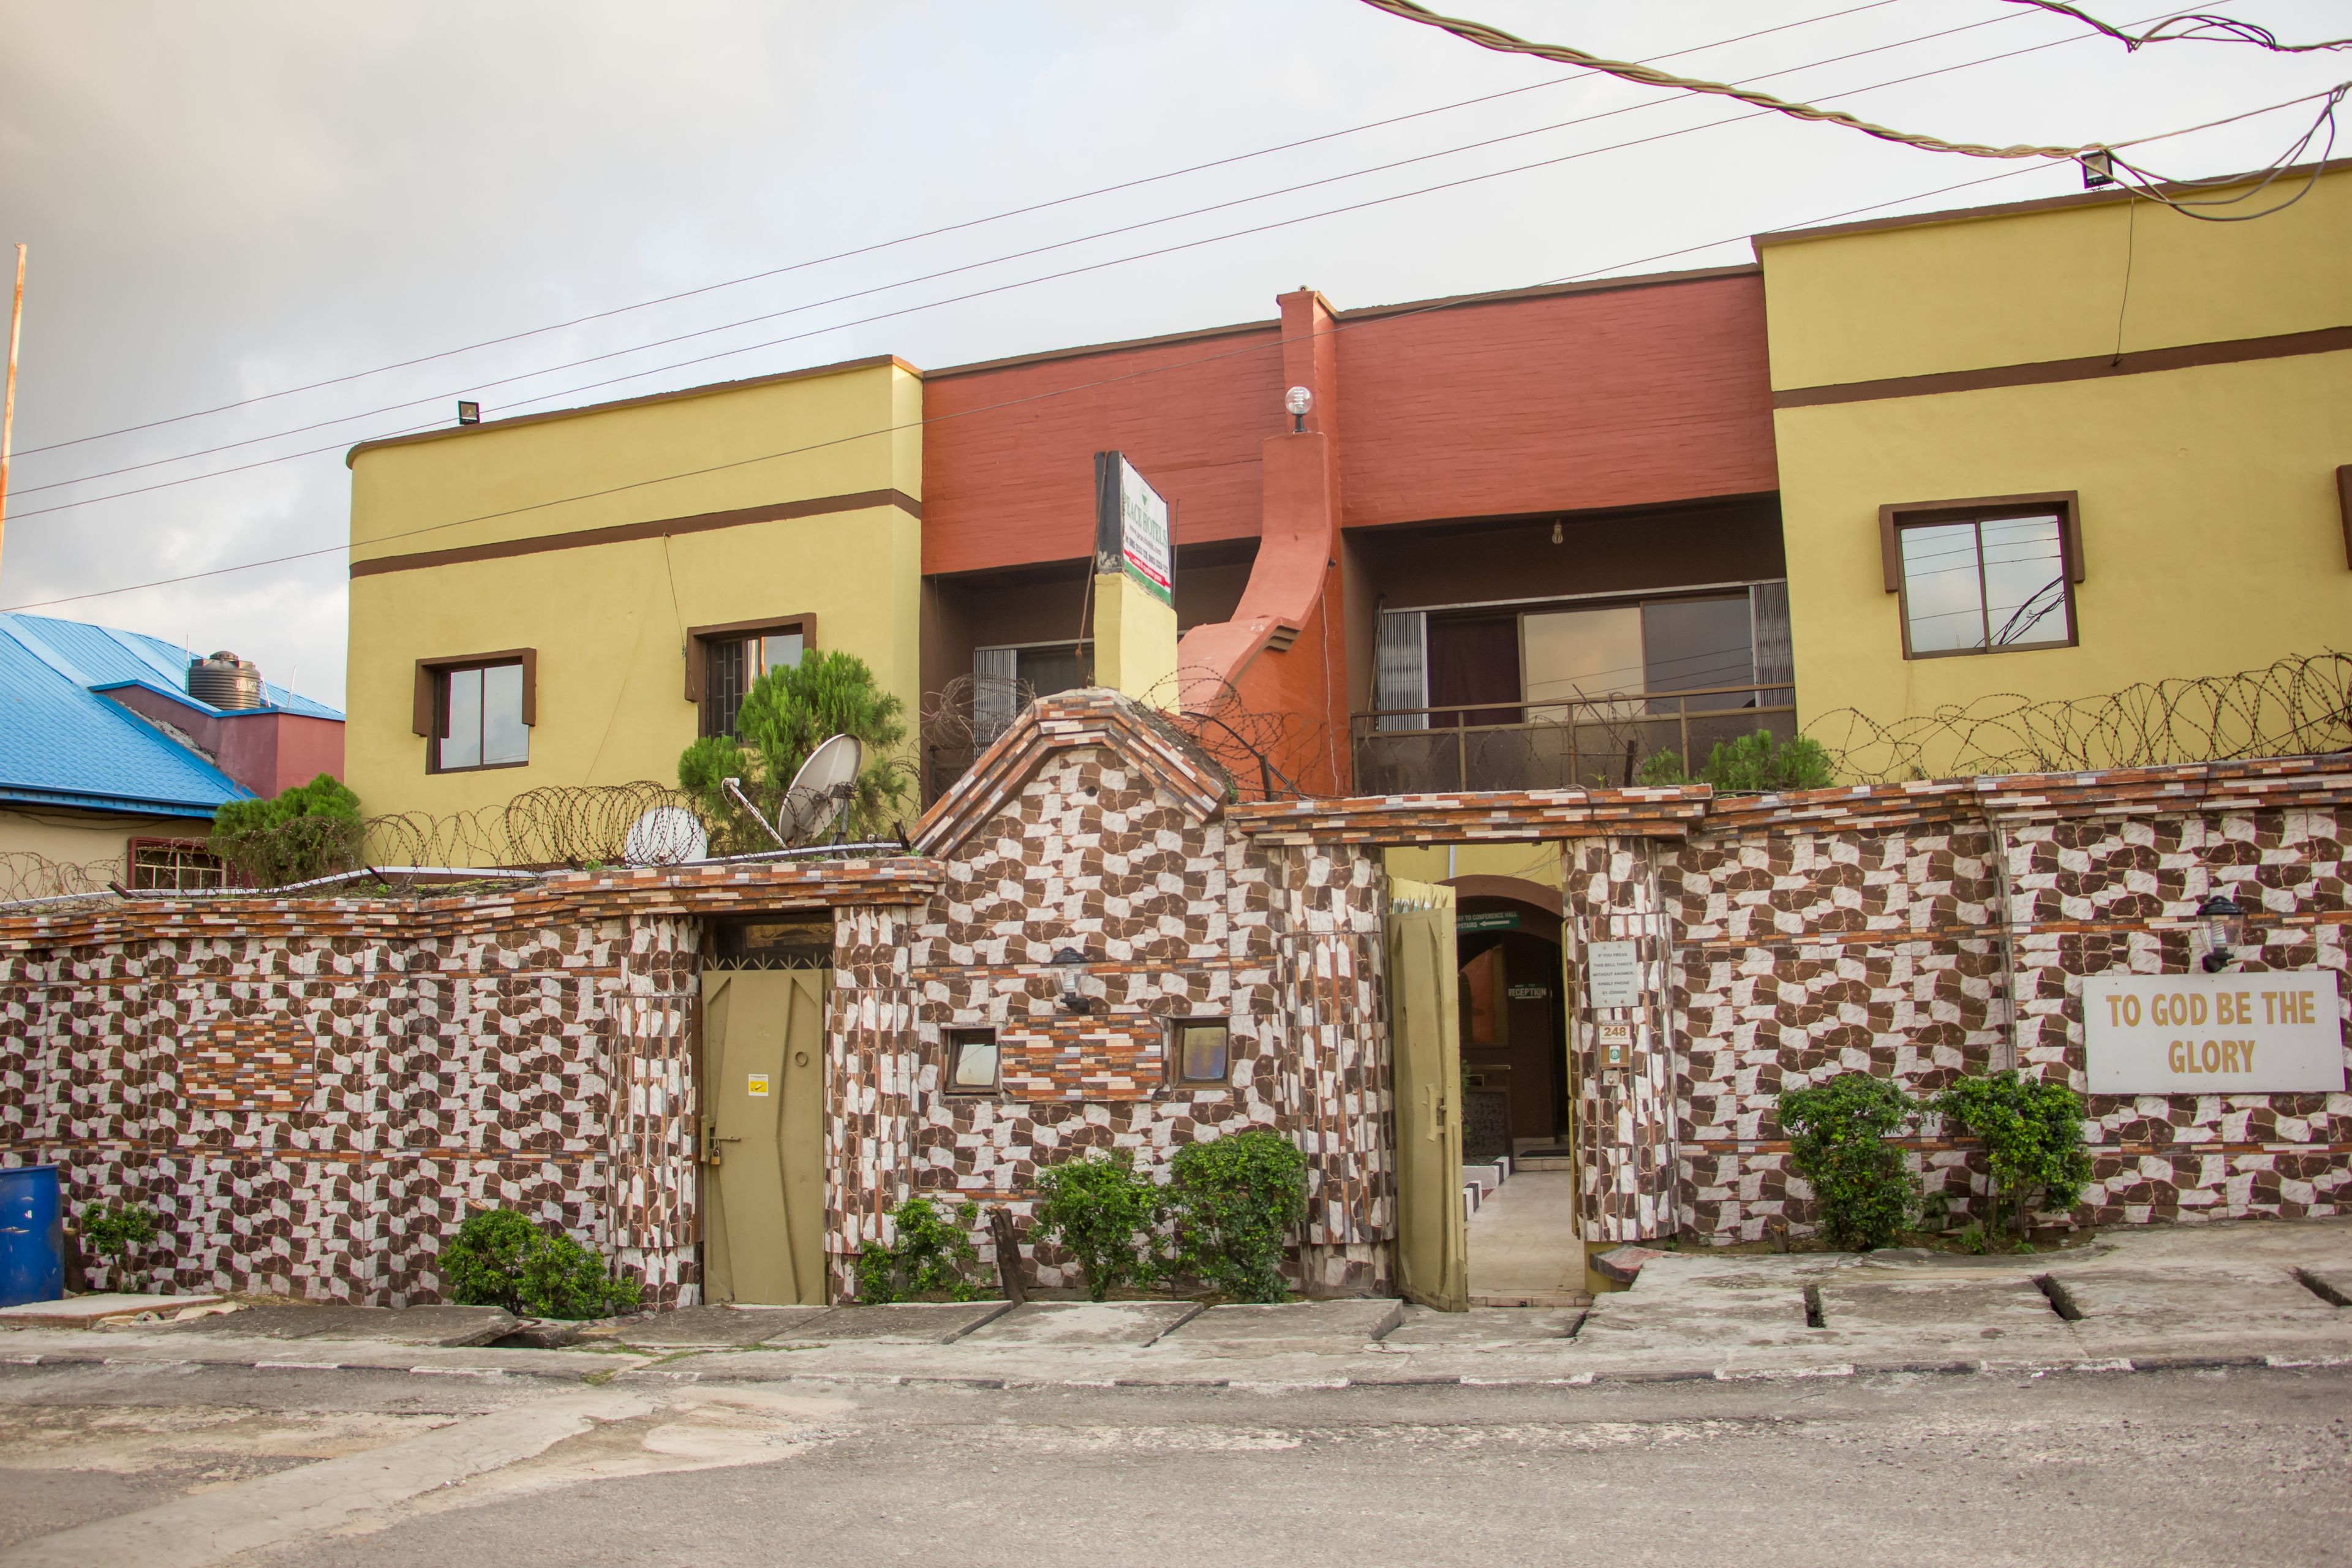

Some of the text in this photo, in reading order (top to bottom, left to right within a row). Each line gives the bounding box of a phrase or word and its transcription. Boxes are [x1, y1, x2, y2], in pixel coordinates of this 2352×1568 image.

[1143, 511, 1167, 547] HOTELS
[1508, 987, 1547, 996] RECEPTION
[2106, 990, 2315, 1027] TO GOD BE THE
[1604, 1027, 1626, 1036] 248
[2168, 1039, 2256, 1074] GLORY
